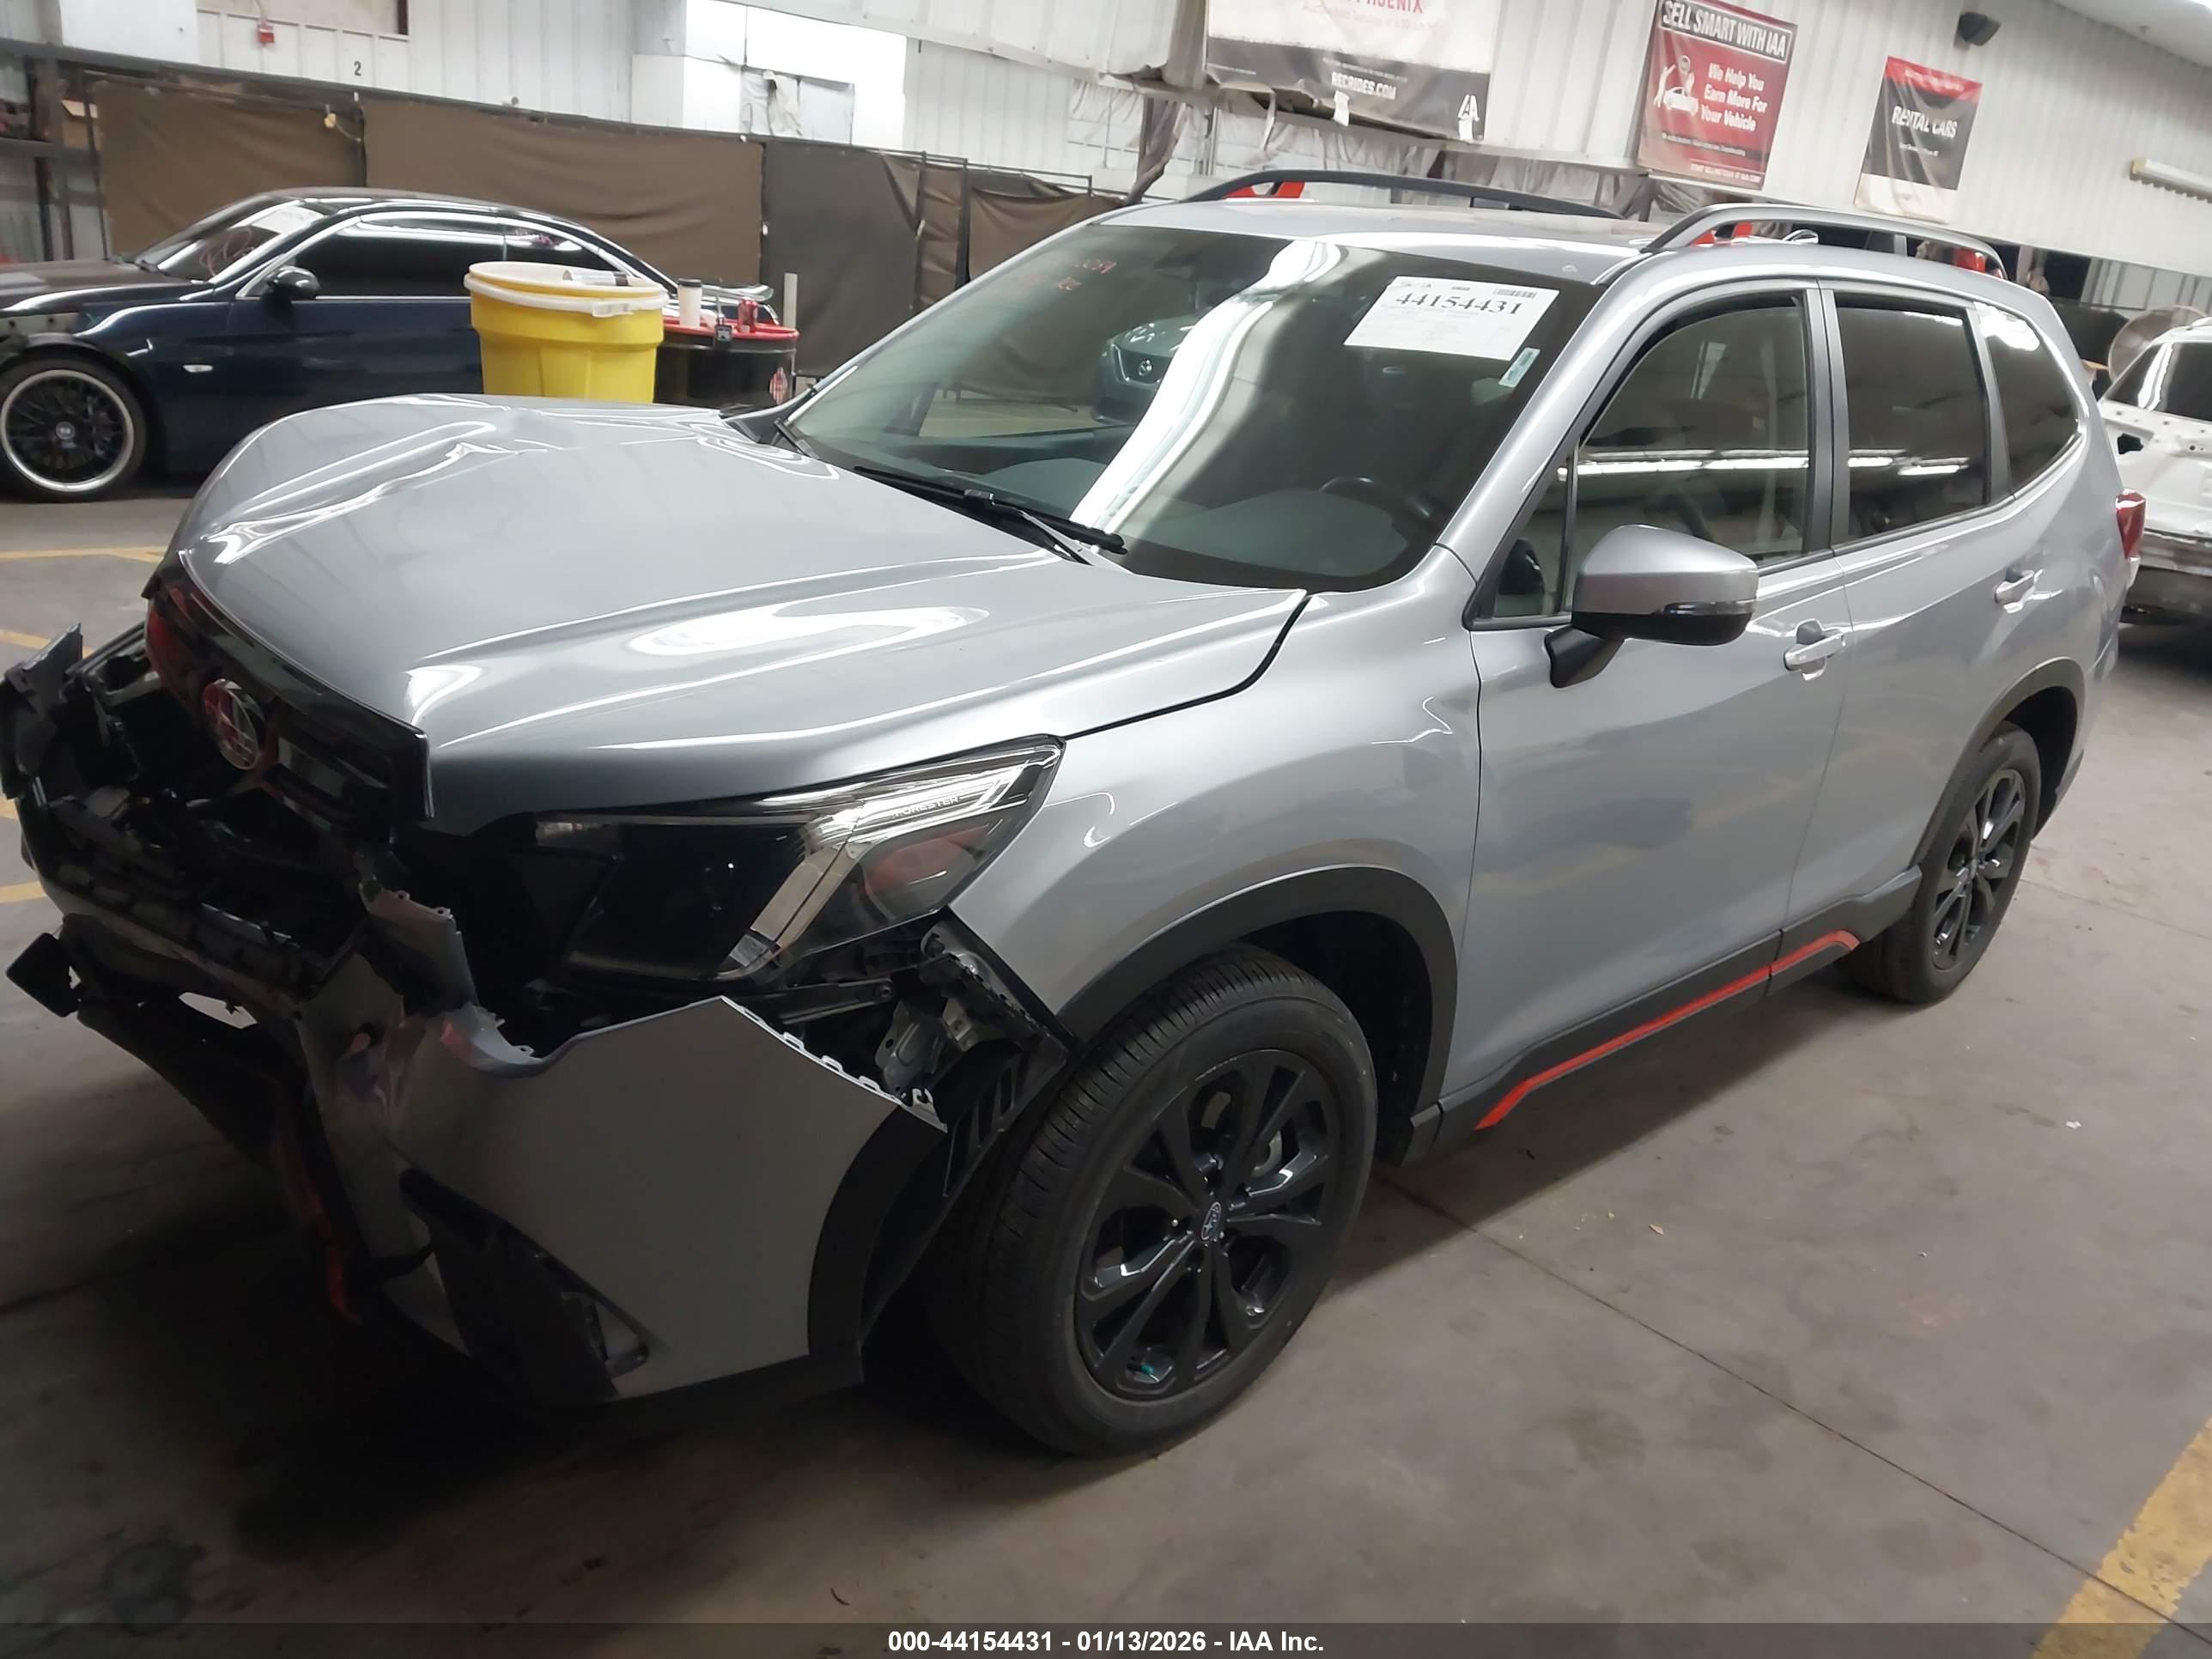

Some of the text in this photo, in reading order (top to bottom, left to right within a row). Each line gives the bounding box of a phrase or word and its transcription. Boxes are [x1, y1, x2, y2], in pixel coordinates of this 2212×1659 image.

[1662, 1, 1786, 58] SELL SMART WITH IAA
[354, 60, 362, 76] 2
[1708, 62, 1765, 92] We Help You
[1704, 82, 1767, 113] Earn More For
[1701, 104, 1756, 131] Your Vehicle
[1892, 106, 1958, 138] RENTAL CARS
[1395, 291, 1523, 314] 44154431
